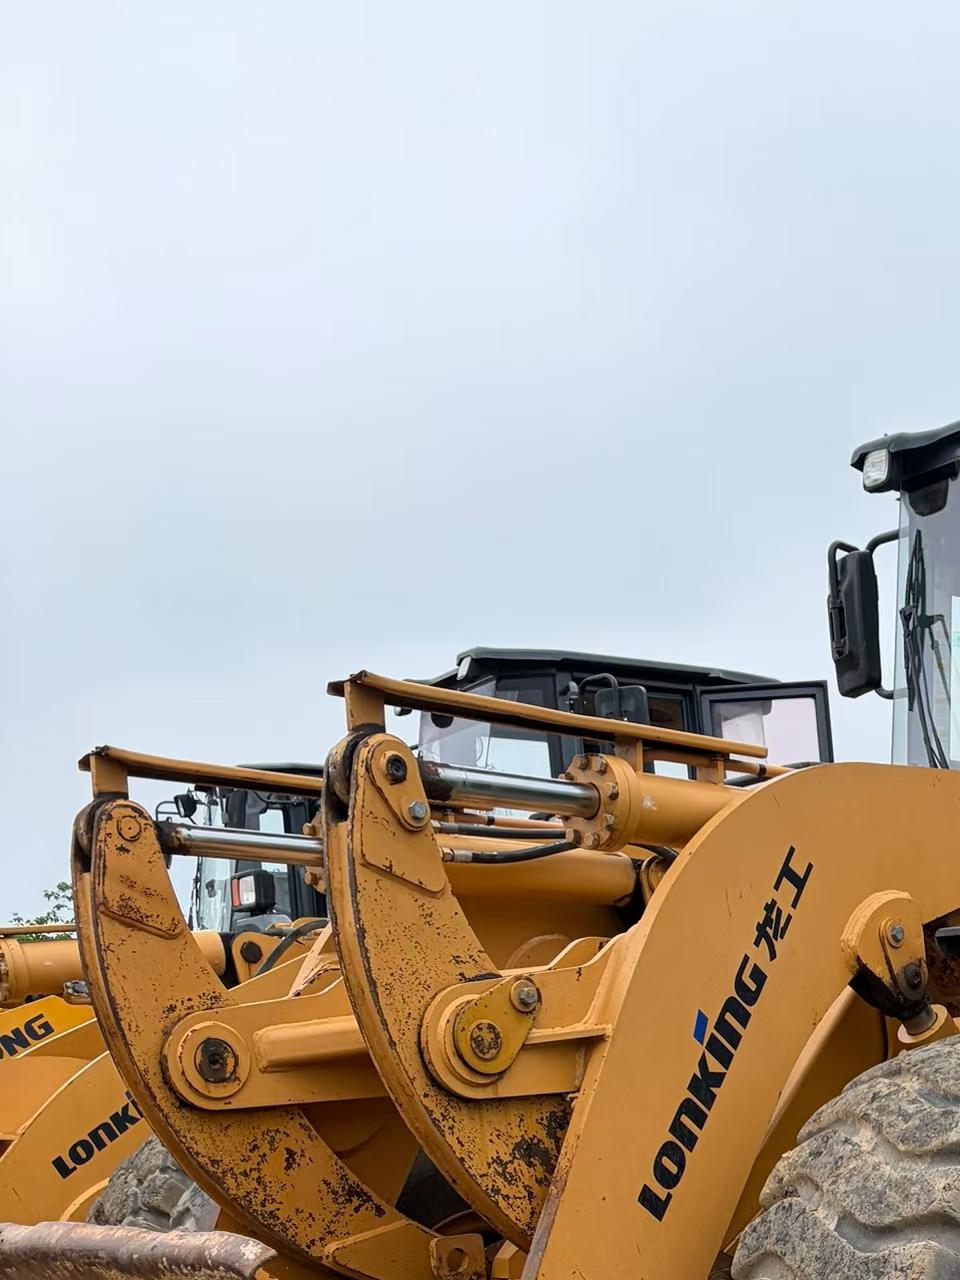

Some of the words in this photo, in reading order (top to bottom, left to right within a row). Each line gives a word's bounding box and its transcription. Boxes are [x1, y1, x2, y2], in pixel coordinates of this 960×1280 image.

[0, 1013, 54, 1060] NG
[637, 953, 768, 1222] LONKING
[753, 845, 813, 962] 龙工
